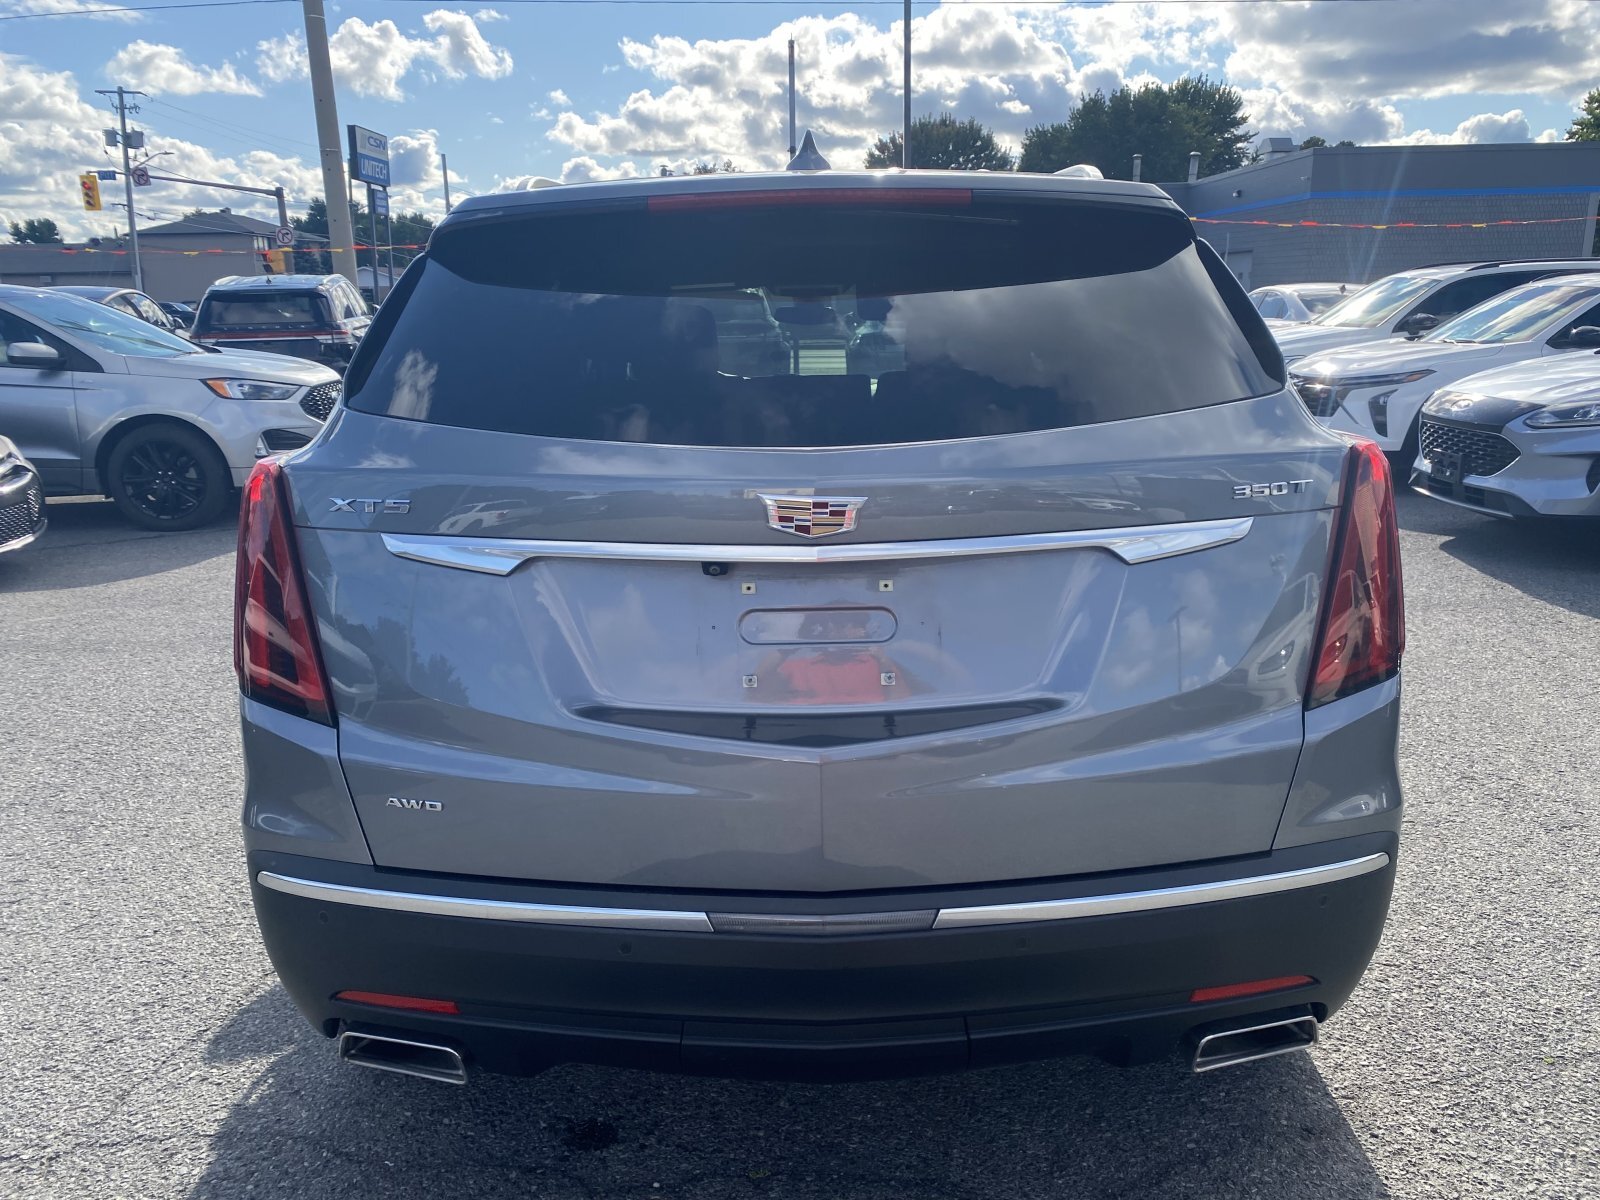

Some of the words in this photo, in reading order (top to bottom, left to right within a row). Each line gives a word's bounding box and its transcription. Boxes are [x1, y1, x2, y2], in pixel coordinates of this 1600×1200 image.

[367, 136, 386, 150] CSN
[361, 158, 387, 179] UNITECH
[1233, 480, 1314, 499] 350T
[329, 498, 411, 514] XT5
[386, 797, 442, 811] AWD
